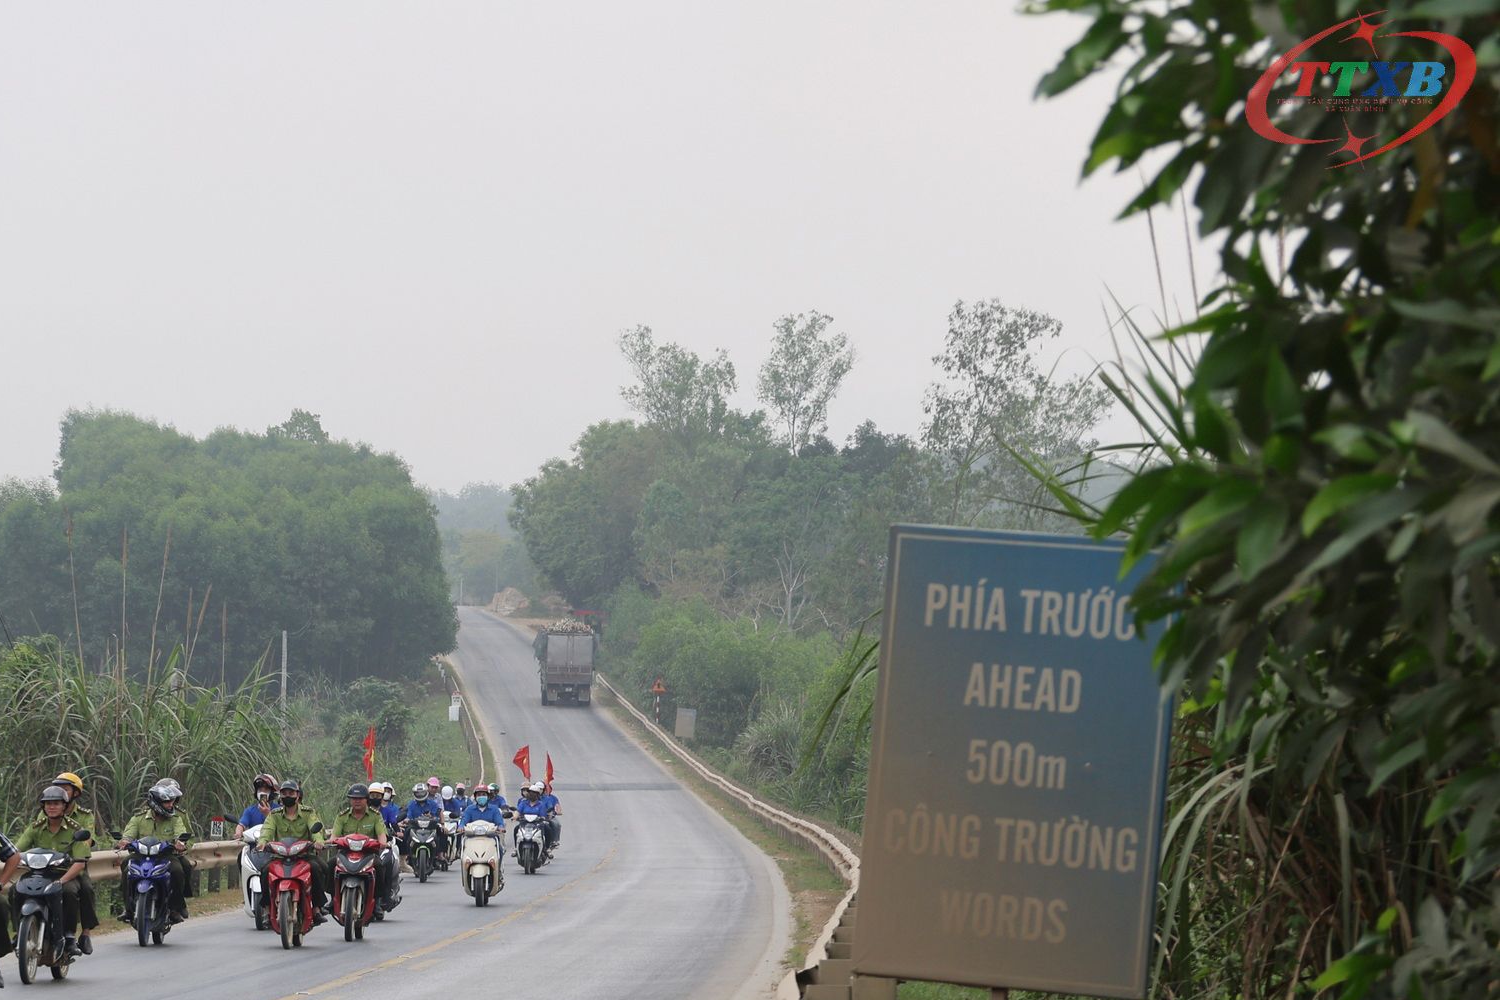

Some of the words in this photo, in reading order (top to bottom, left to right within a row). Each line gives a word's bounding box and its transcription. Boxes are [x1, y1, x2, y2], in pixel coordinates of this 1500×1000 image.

[924, 577, 1007, 632] PHÍA
[1020, 585, 1137, 642] TRƯỚC
[963, 662, 1083, 714] AHEAD
[966, 739, 1068, 790] 500m
[883, 803, 982, 860] CÔNG
[995, 815, 1139, 873] TRƯỜNG
[940, 889, 1069, 944] WORDS
